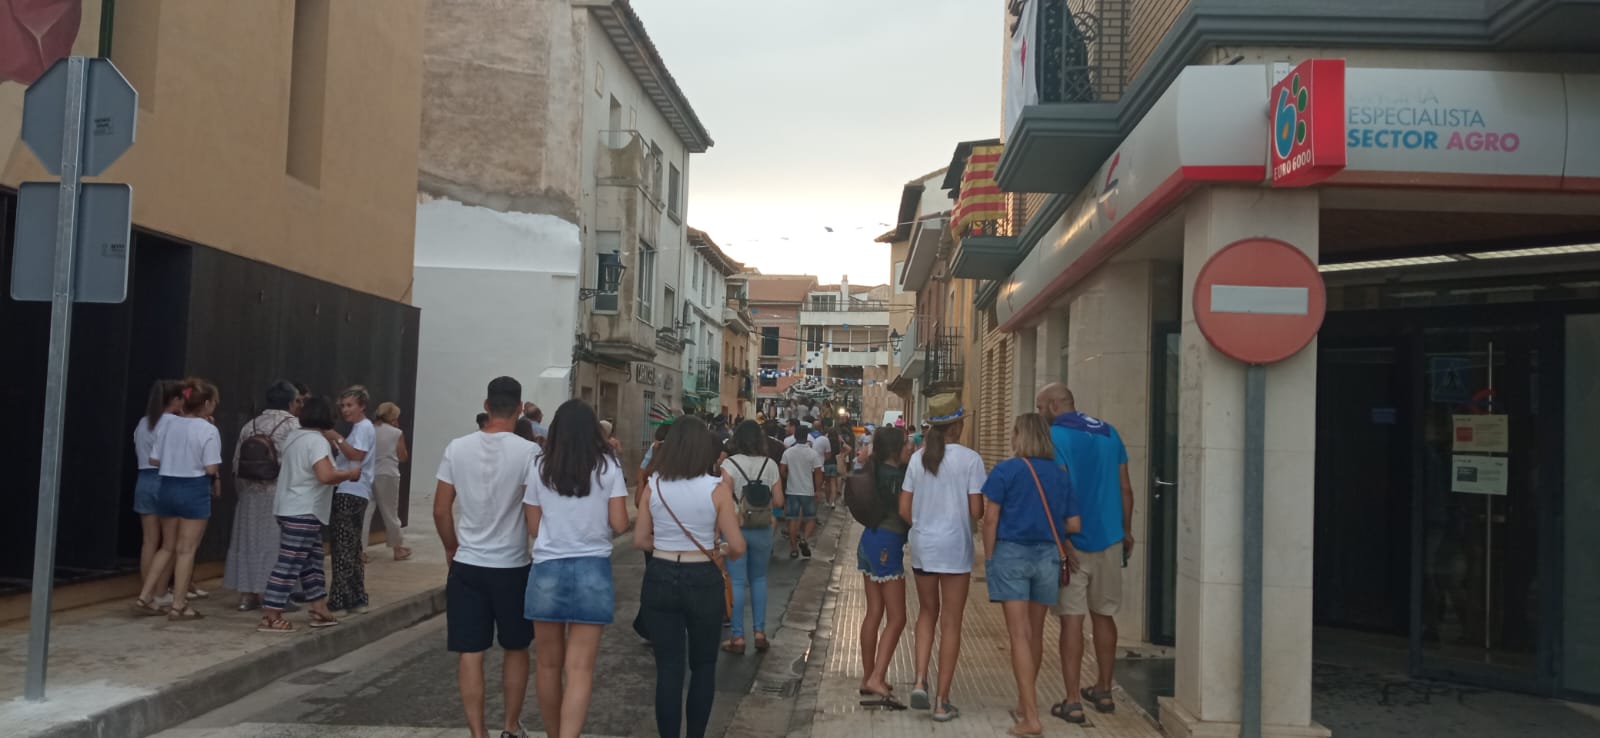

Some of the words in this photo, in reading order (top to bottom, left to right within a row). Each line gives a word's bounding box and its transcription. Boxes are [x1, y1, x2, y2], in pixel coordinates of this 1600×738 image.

[1348, 106, 1486, 128] ESPECIALISTA
[1347, 129, 1438, 150] SECTOR
[1446, 131, 1520, 152] AGRO
[1273, 159, 1291, 181] EURO
[1292, 148, 1312, 172] 6000
